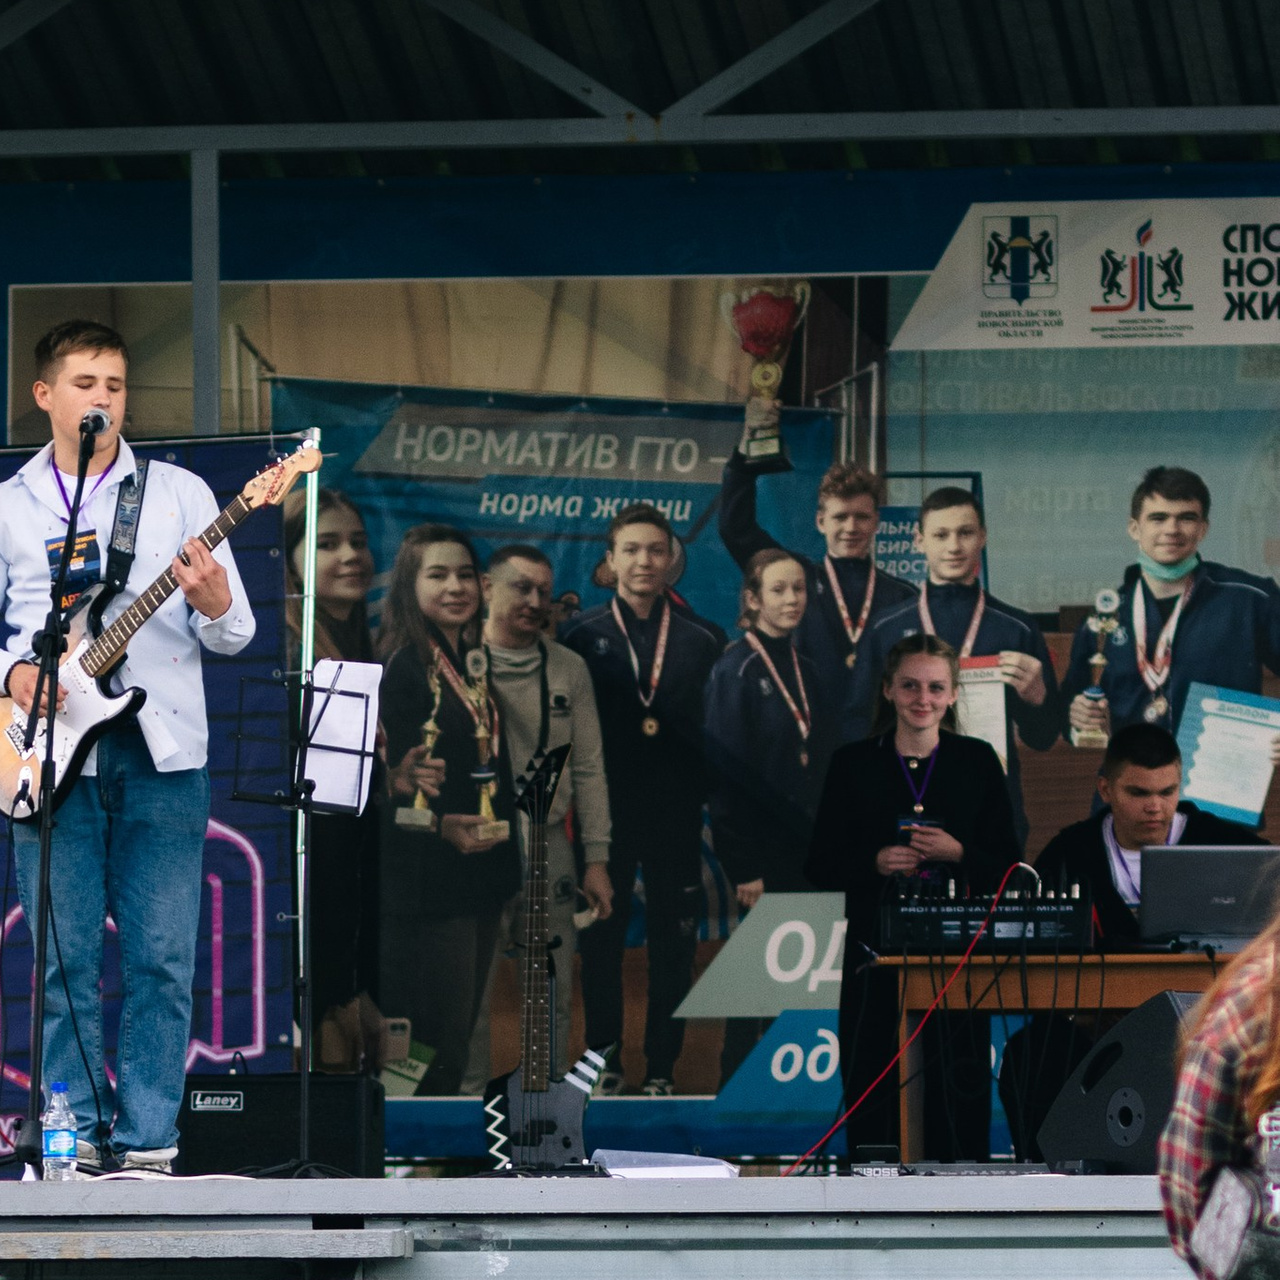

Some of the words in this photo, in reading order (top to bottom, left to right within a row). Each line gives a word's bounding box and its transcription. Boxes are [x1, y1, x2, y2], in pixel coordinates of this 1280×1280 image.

[1223, 257, 1280, 287] НО
[394, 422, 620, 470] НОРМАТИВ
[629, 435, 700, 473] ГТО
[479, 492, 584, 522] норма
[591, 496, 692, 521] жни
[771, 1028, 840, 1083] од
[195, 1093, 239, 1108] Laney
[863, 1167, 899, 1177] BOSS
